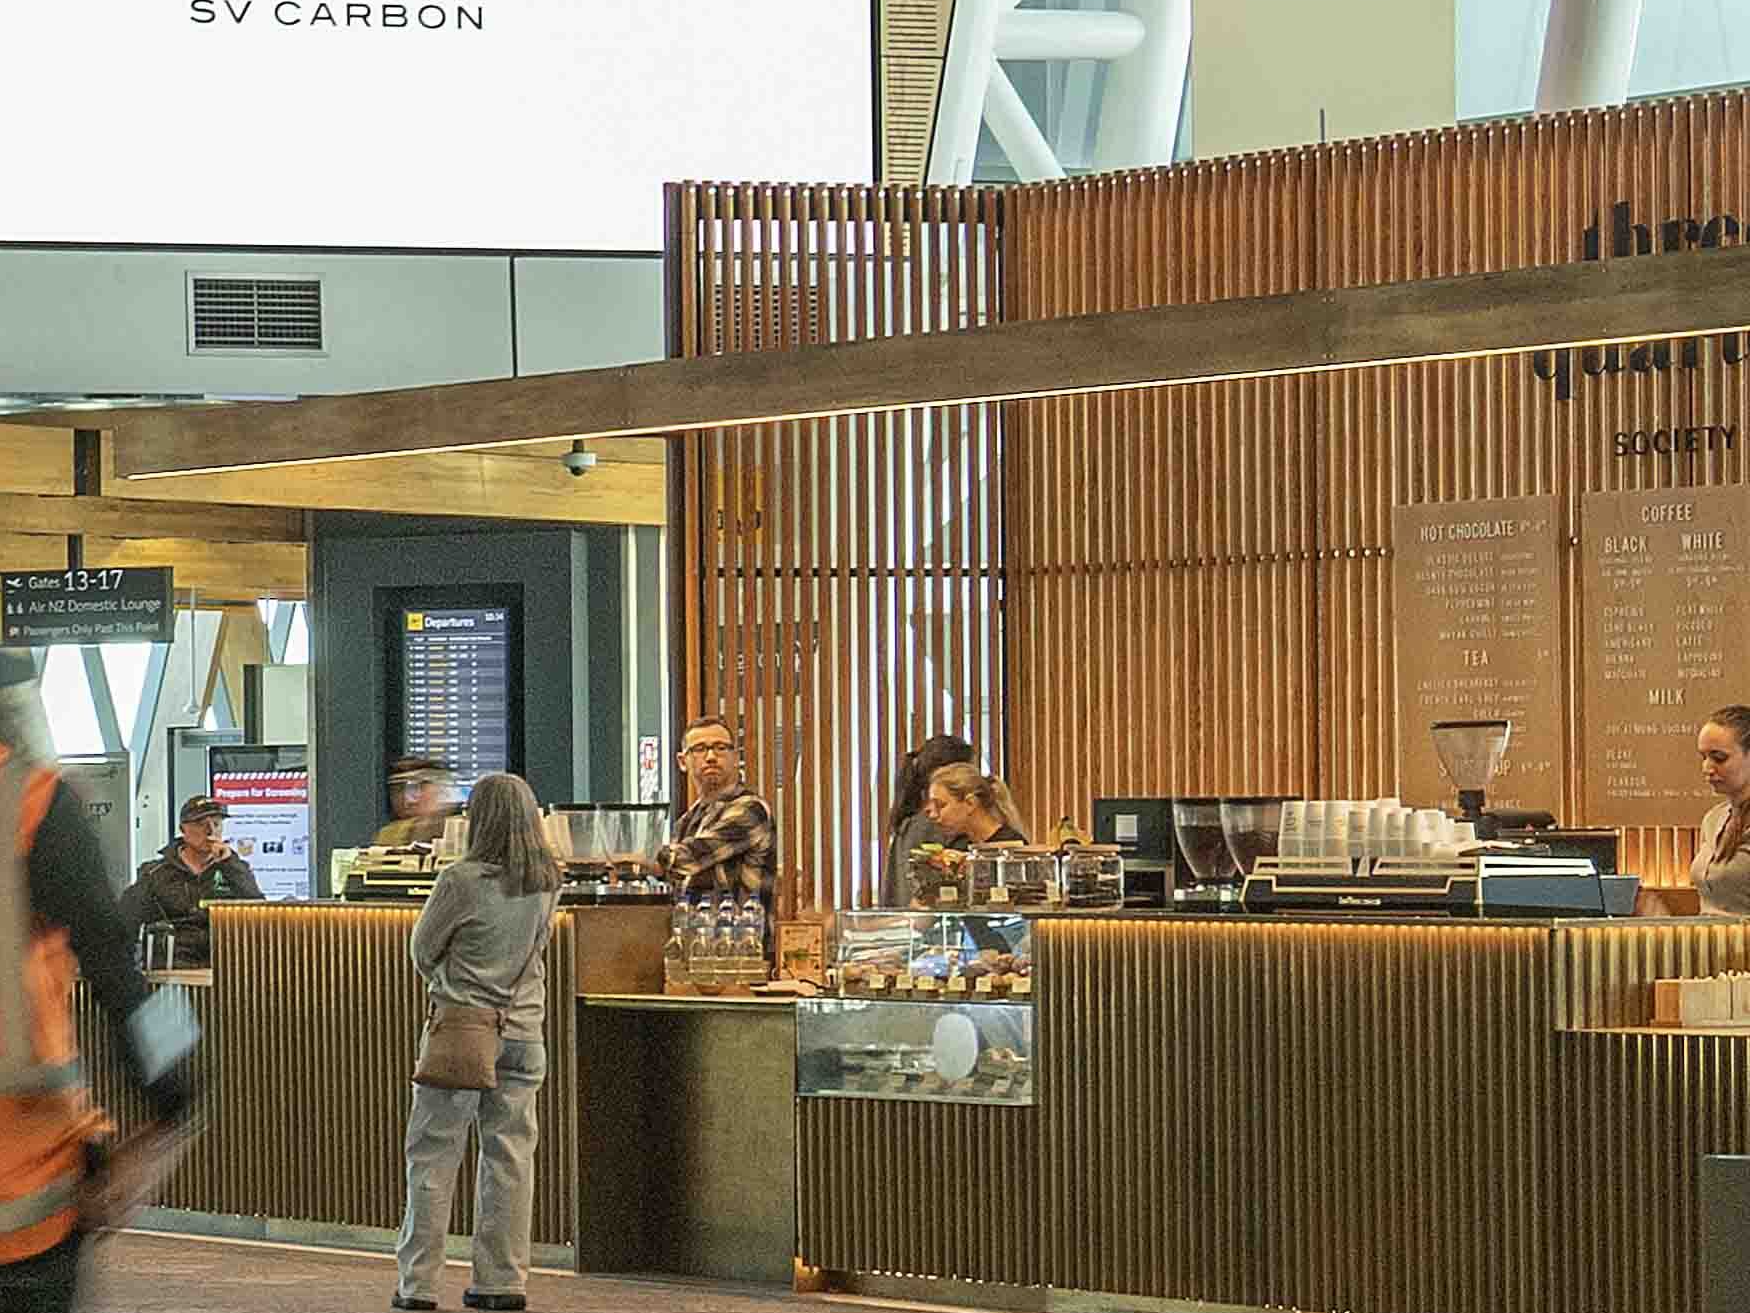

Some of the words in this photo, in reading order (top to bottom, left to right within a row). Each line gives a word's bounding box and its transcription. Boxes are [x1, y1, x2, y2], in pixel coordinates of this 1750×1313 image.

[274, 0, 483, 30] CARBON
[1614, 425, 1736, 456] SOCIETY
[1642, 503, 1693, 522] COFFEE
[1420, 525, 1445, 541] HOT
[1448, 520, 1515, 540] CHOCOLATE
[1605, 536, 1648, 553] BLACK
[1681, 532, 1723, 551] WHITE
[28, 576, 61, 589] Gates
[64, 569, 124, 591] 13-17
[28, 600, 46, 613] Air
[49, 600, 65, 613] NZ
[68, 599, 117, 612] Domestic
[121, 597, 161, 612] Lounge
[1463, 649, 1489, 666] TEA
[1649, 688, 1685, 705] MILK
